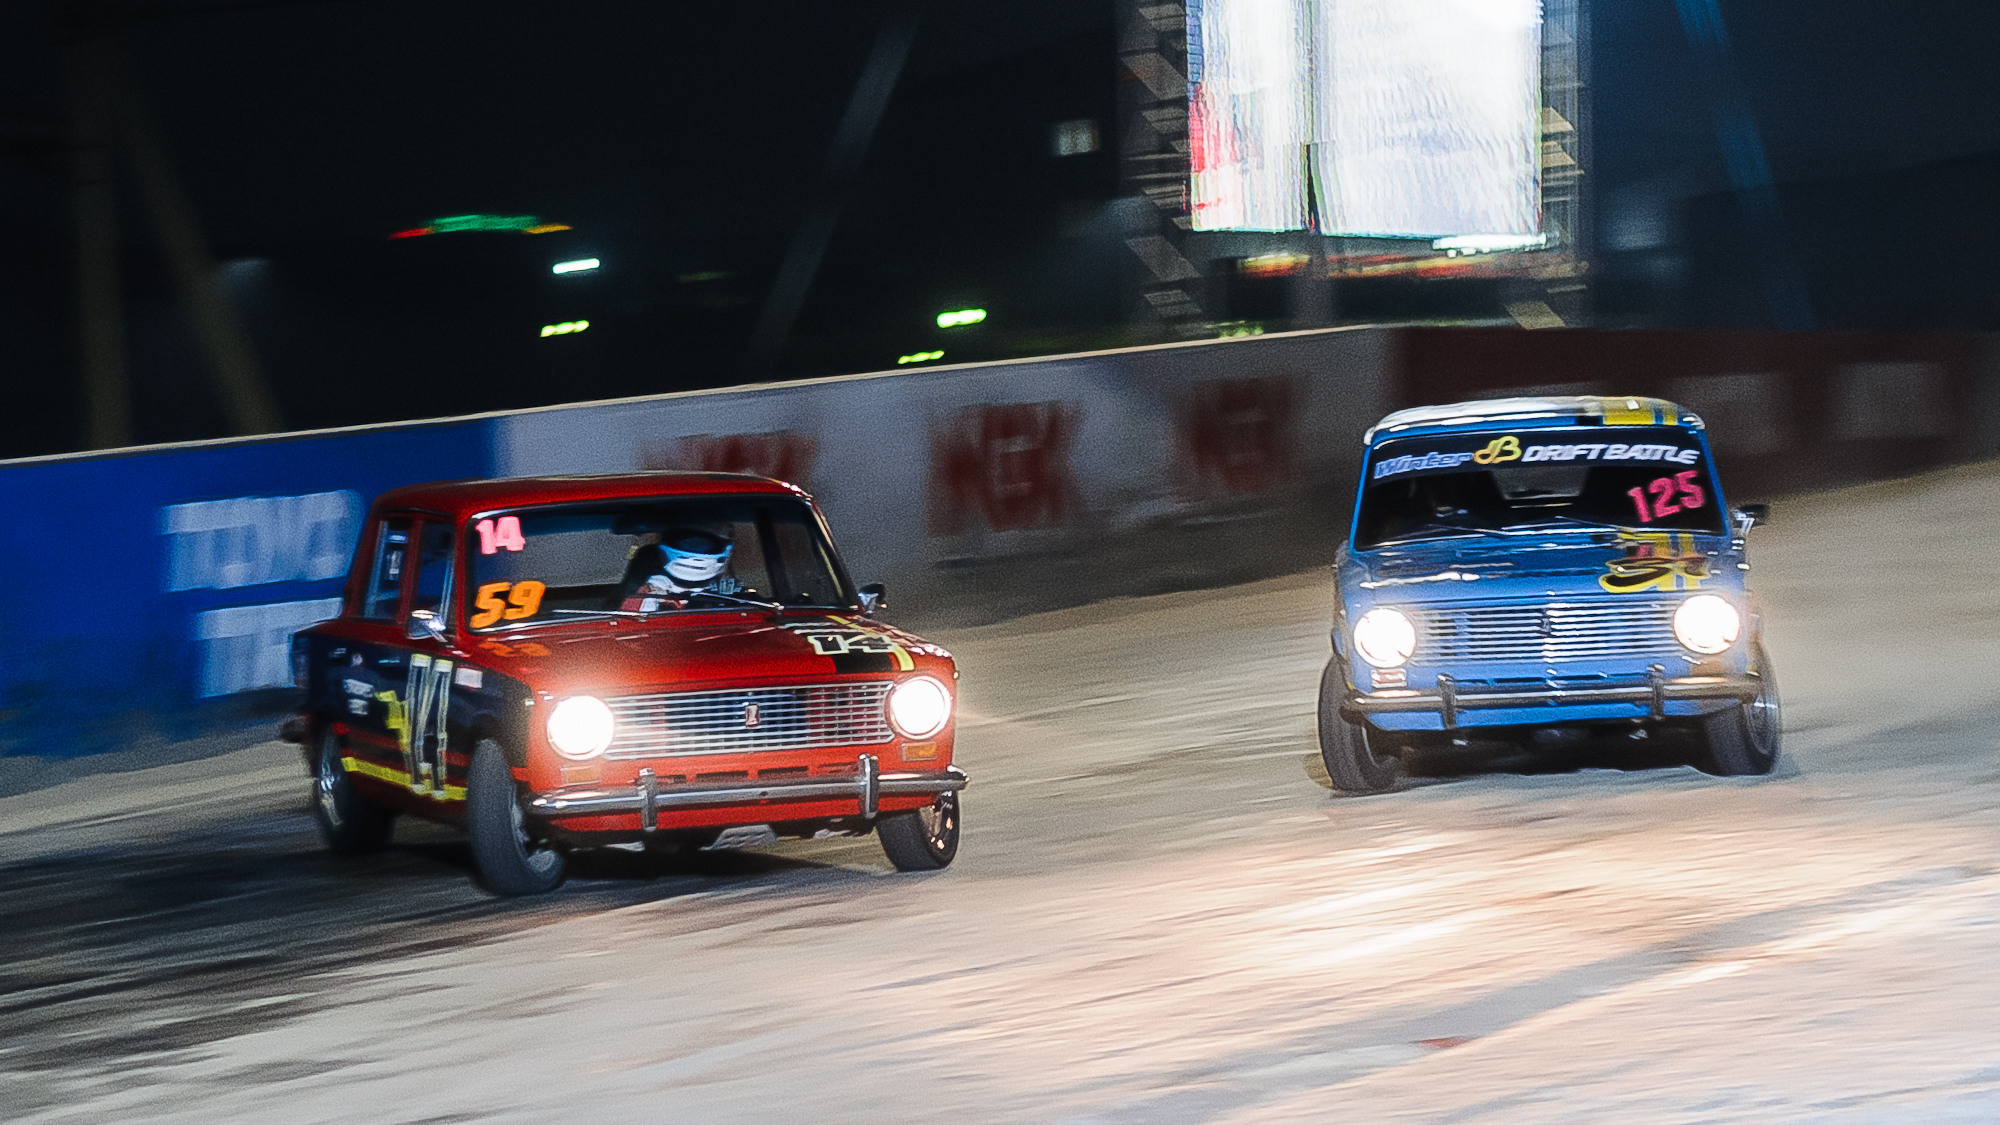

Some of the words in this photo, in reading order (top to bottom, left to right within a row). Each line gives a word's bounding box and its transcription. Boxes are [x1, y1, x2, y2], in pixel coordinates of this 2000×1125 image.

[1374, 452, 1474, 479] Winter
[1521, 444, 1607, 463] DRIFT
[1602, 444, 1701, 465] BATTLE
[1628, 469, 1705, 523] 125
[475, 516, 526, 555] 14
[469, 580, 547, 629] 59
